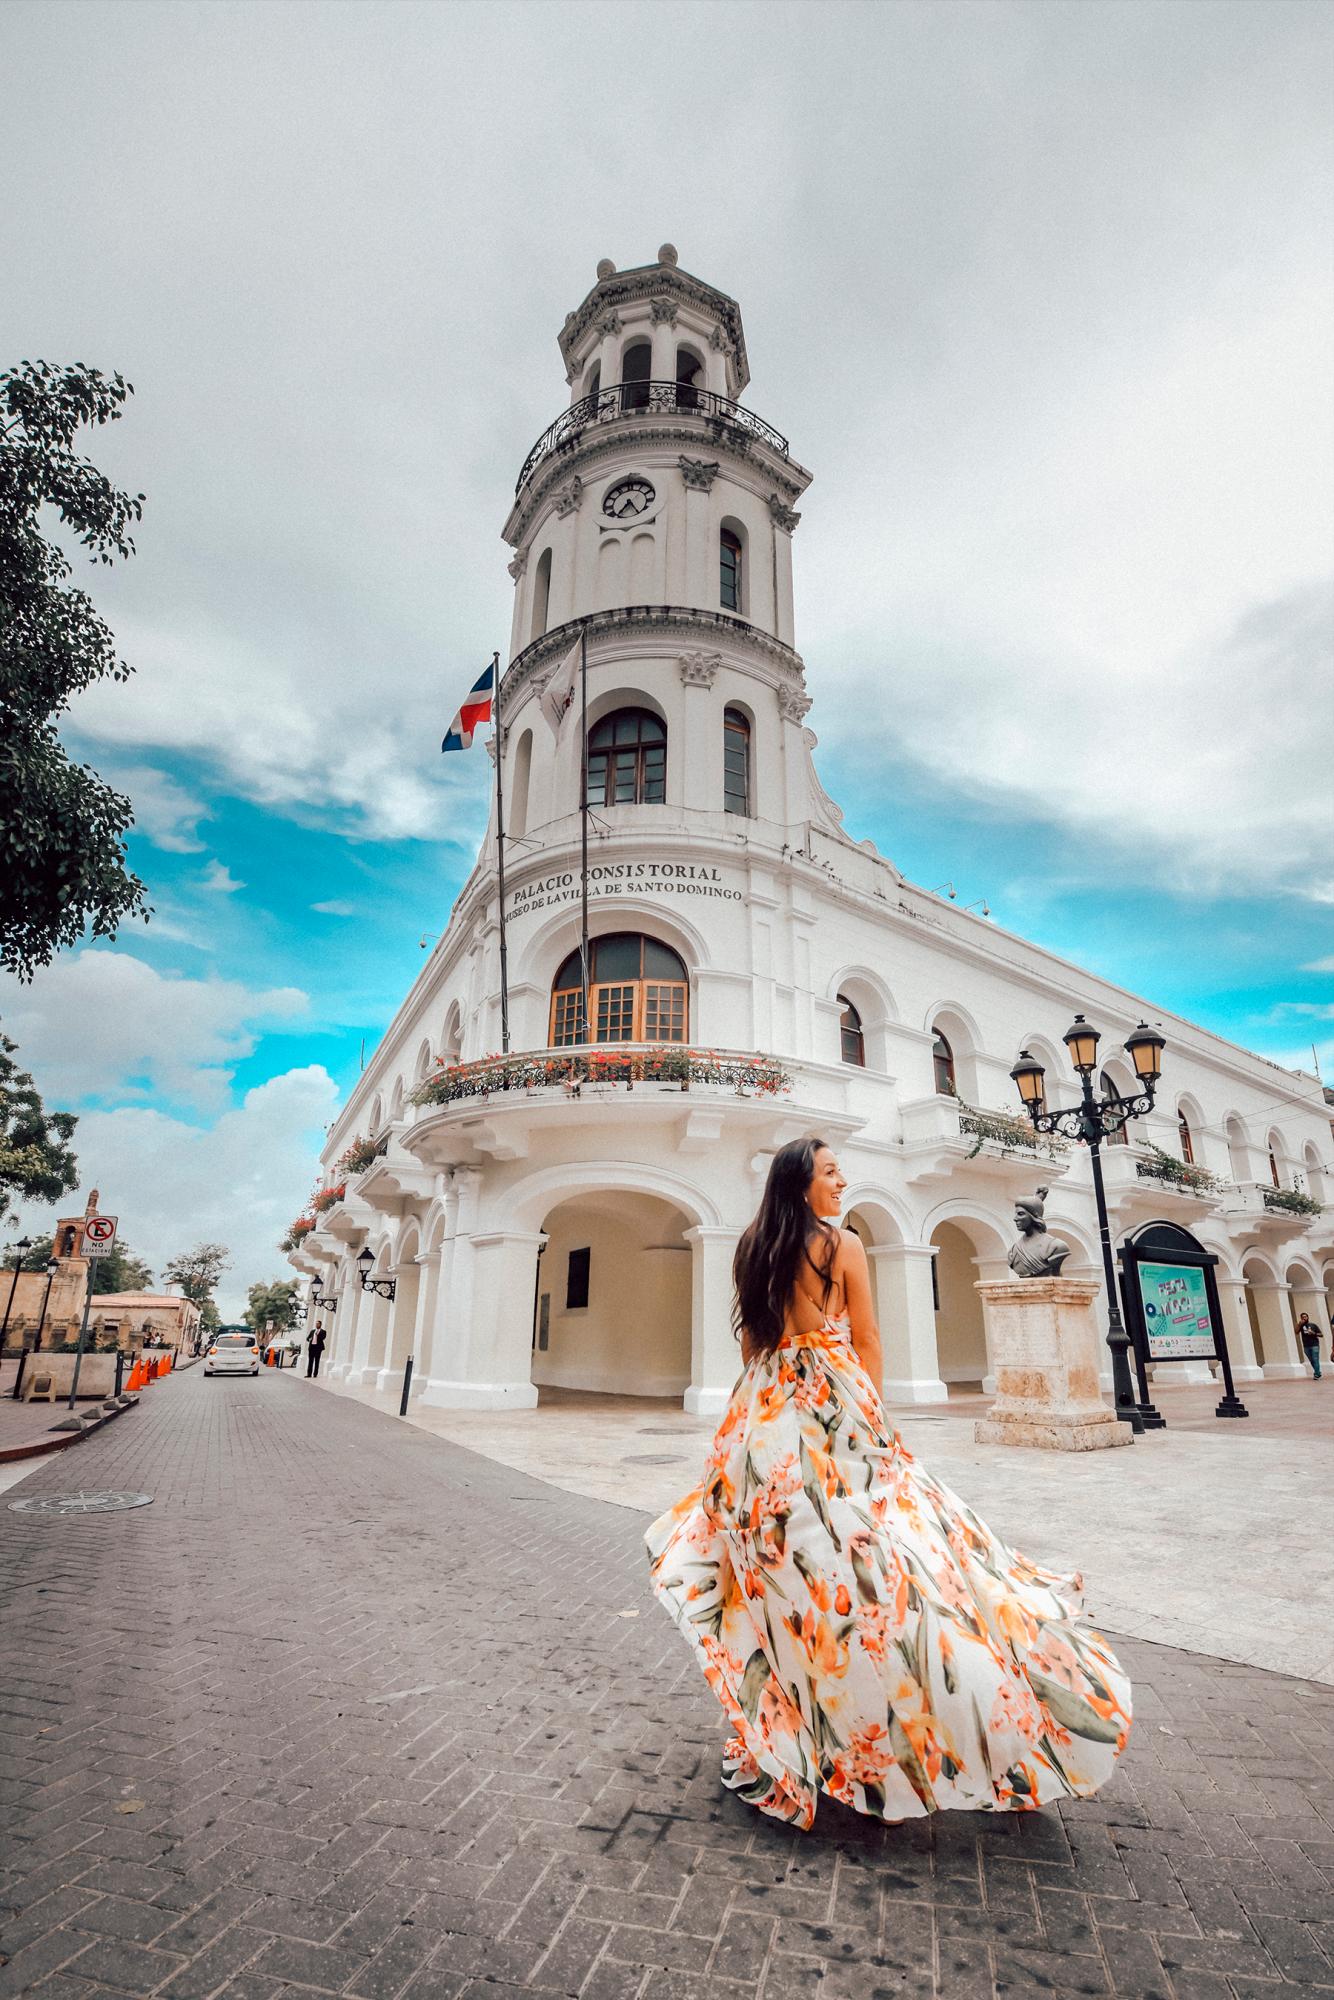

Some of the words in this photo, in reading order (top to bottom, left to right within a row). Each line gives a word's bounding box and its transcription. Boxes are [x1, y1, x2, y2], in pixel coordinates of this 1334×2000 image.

[514, 874, 573, 904] PALACIO
[581, 864, 722, 881] CONSISTORIAL
[531, 898, 545, 911] DE
[547, 893, 561, 905] LA
[605, 884, 622, 894] DE
[627, 882, 674, 892] SANTO
[677, 883, 742, 901] DOMINGO
